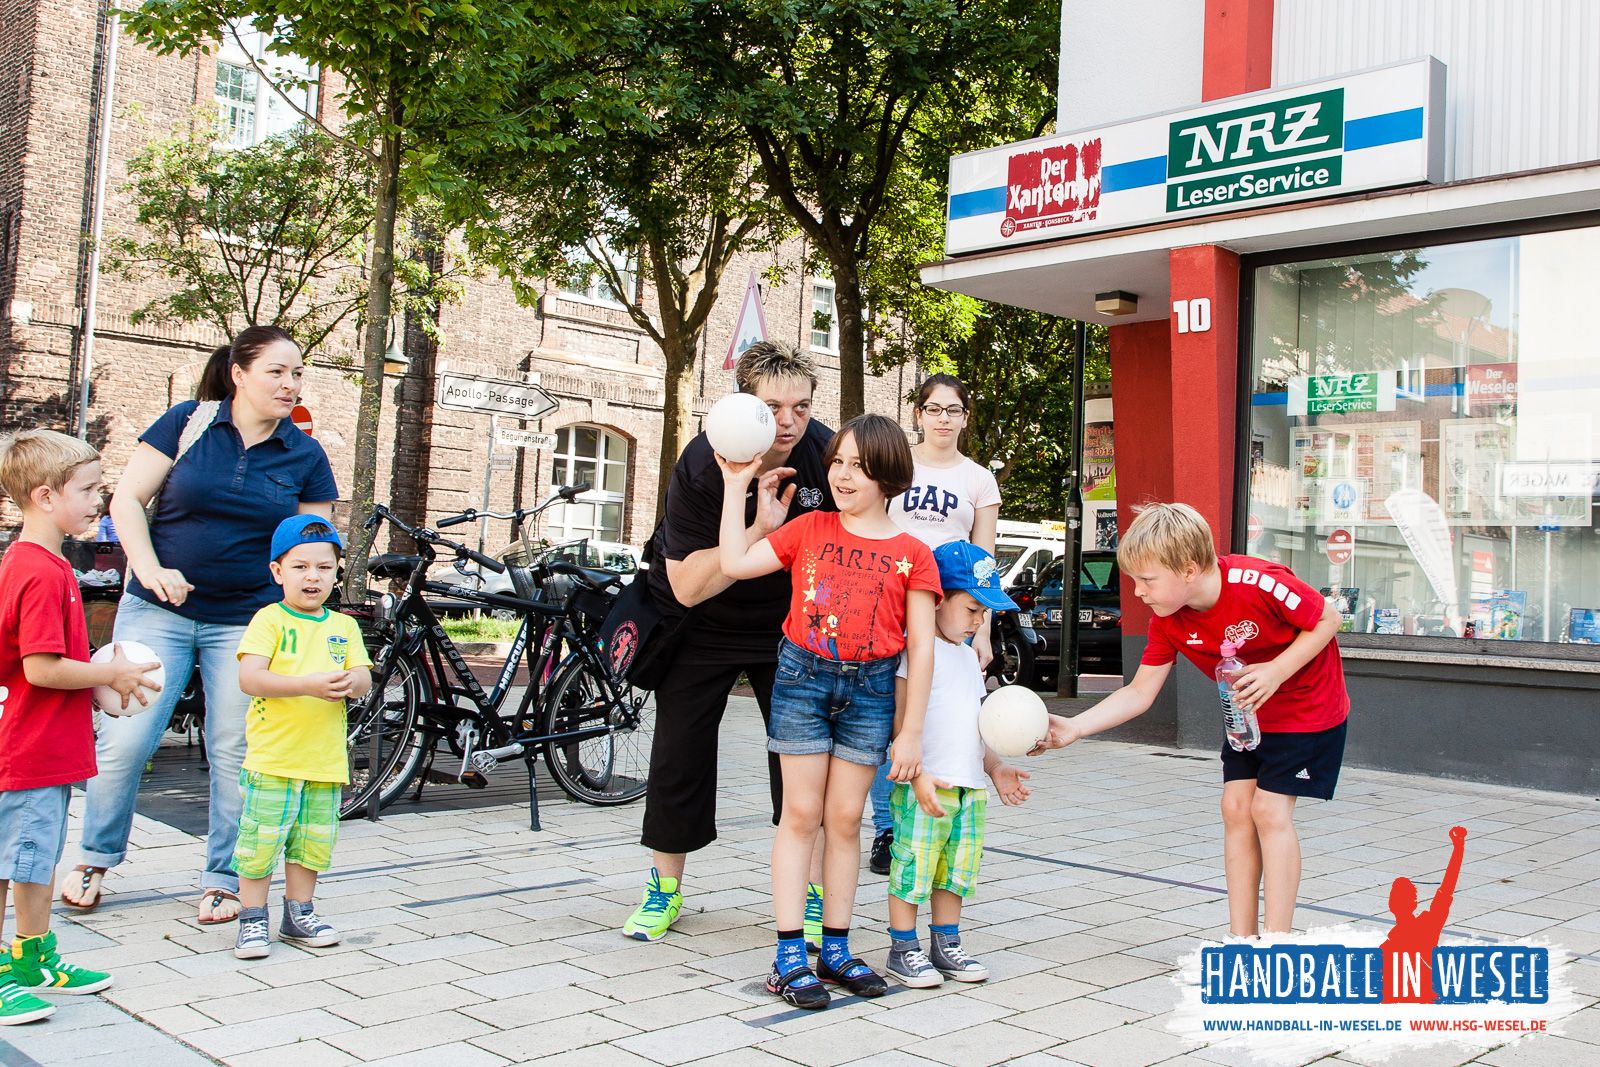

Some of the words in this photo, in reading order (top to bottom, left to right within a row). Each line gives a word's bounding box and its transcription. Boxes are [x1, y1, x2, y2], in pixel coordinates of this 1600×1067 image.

[1179, 101, 1331, 168] NRZ
[1041, 158, 1068, 178] Der
[1176, 166, 1329, 207] LeserService
[1173, 298, 1211, 333] 10
[1485, 368, 1503, 380] Der
[1312, 376, 1372, 395] NRZ
[446, 385, 534, 408] Apollo-Passage
[1311, 399, 1372, 412] LeserService
[501, 430, 552, 446] Beguinenstraße
[1094, 448, 1113, 456] 2014
[903, 485, 959, 518] GAP
[911, 511, 927, 520] New
[928, 514, 945, 523] York
[818, 542, 892, 574] PARIS
[814, 587, 833, 606] BE
[280, 625, 297, 654] 11
